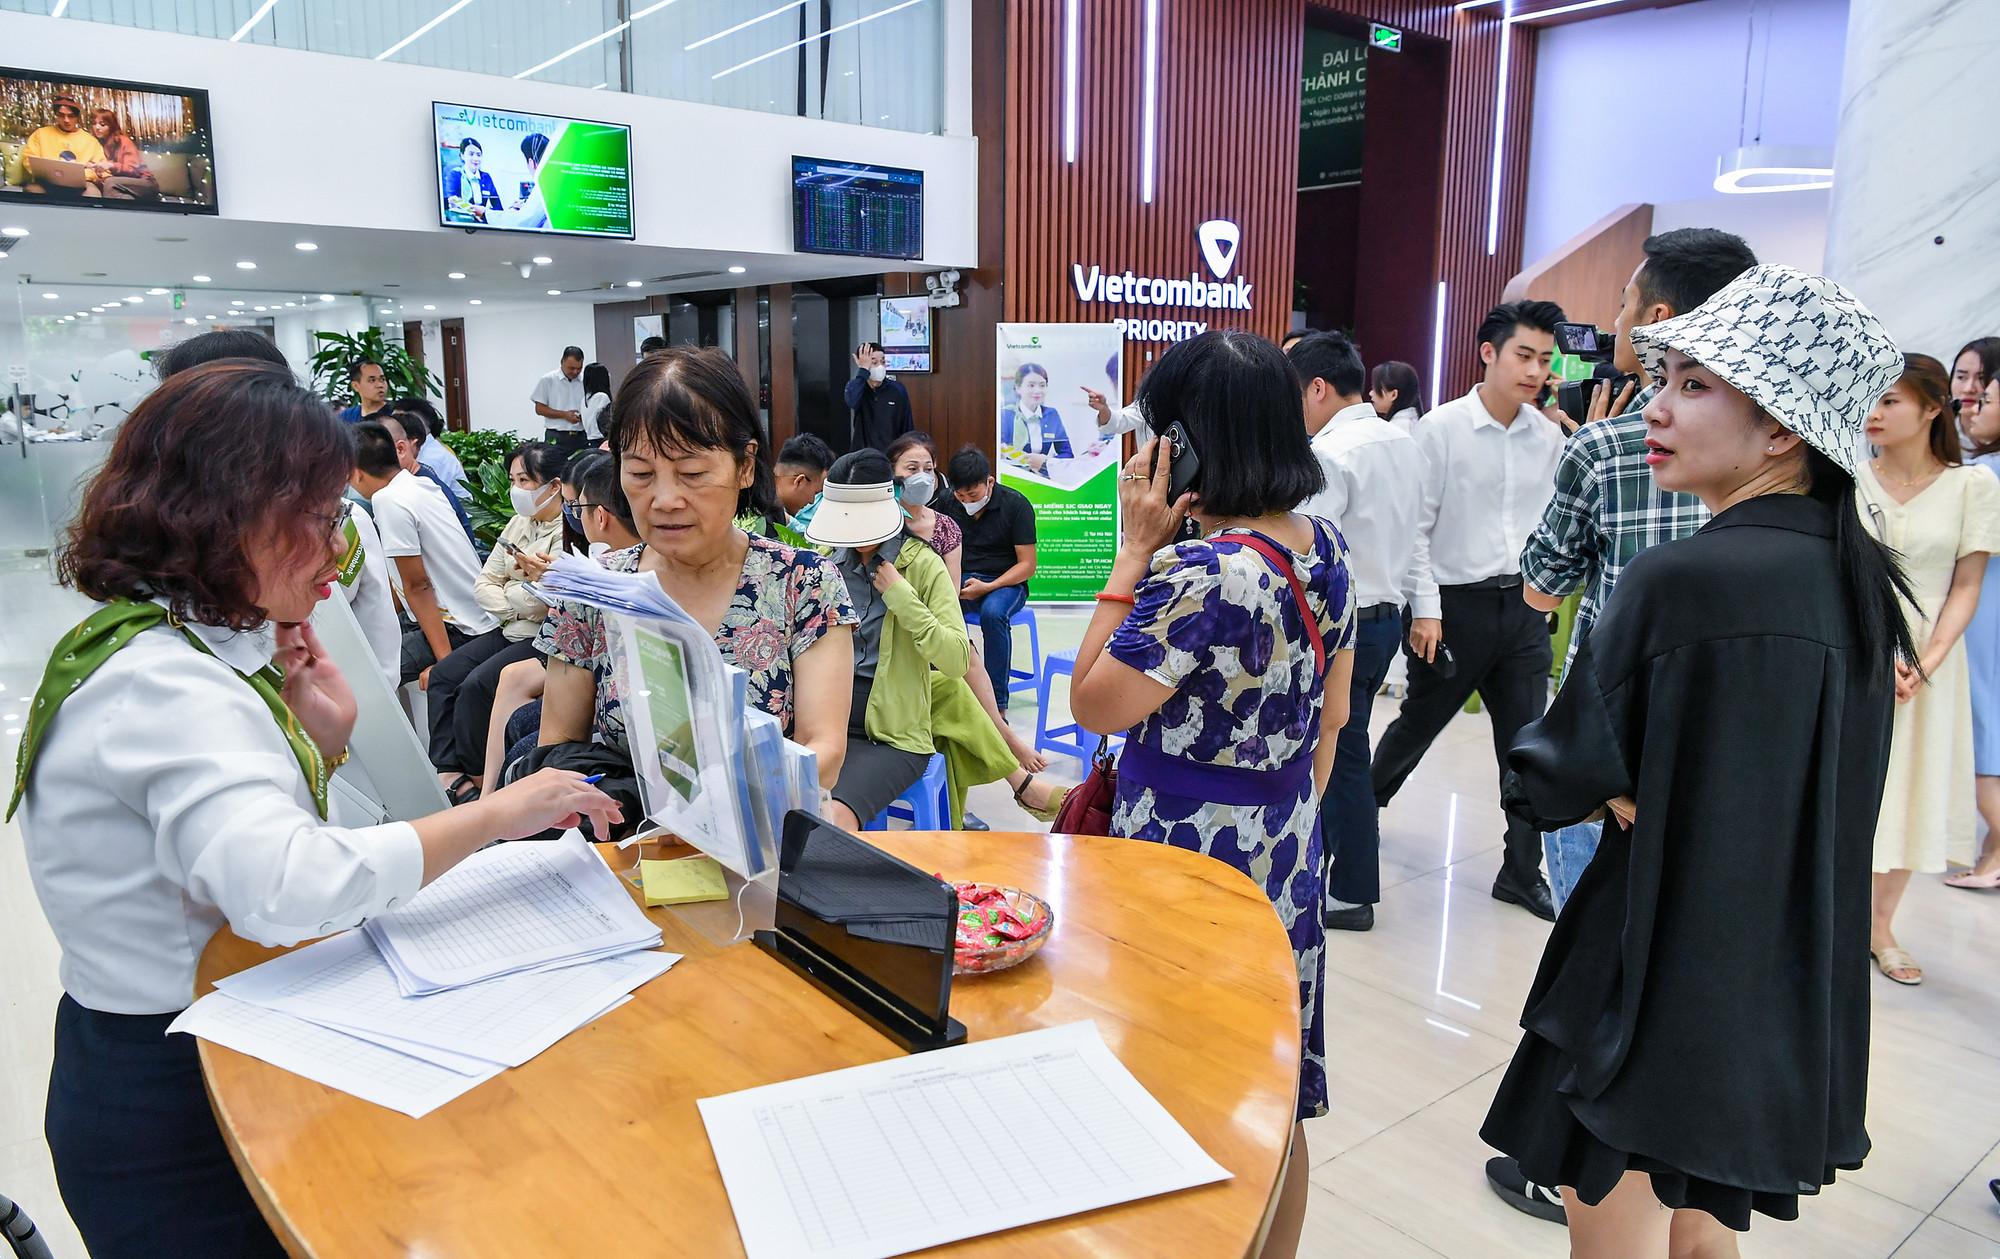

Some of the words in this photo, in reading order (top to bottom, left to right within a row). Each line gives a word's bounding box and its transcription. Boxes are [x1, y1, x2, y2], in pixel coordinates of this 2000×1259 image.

[1322, 48, 1349, 68] ĐẠI
[1073, 264, 1252, 310] Vietcombank
[1114, 318, 1207, 342] PRIORITY
[299, 728, 324, 800] Vietcombank
